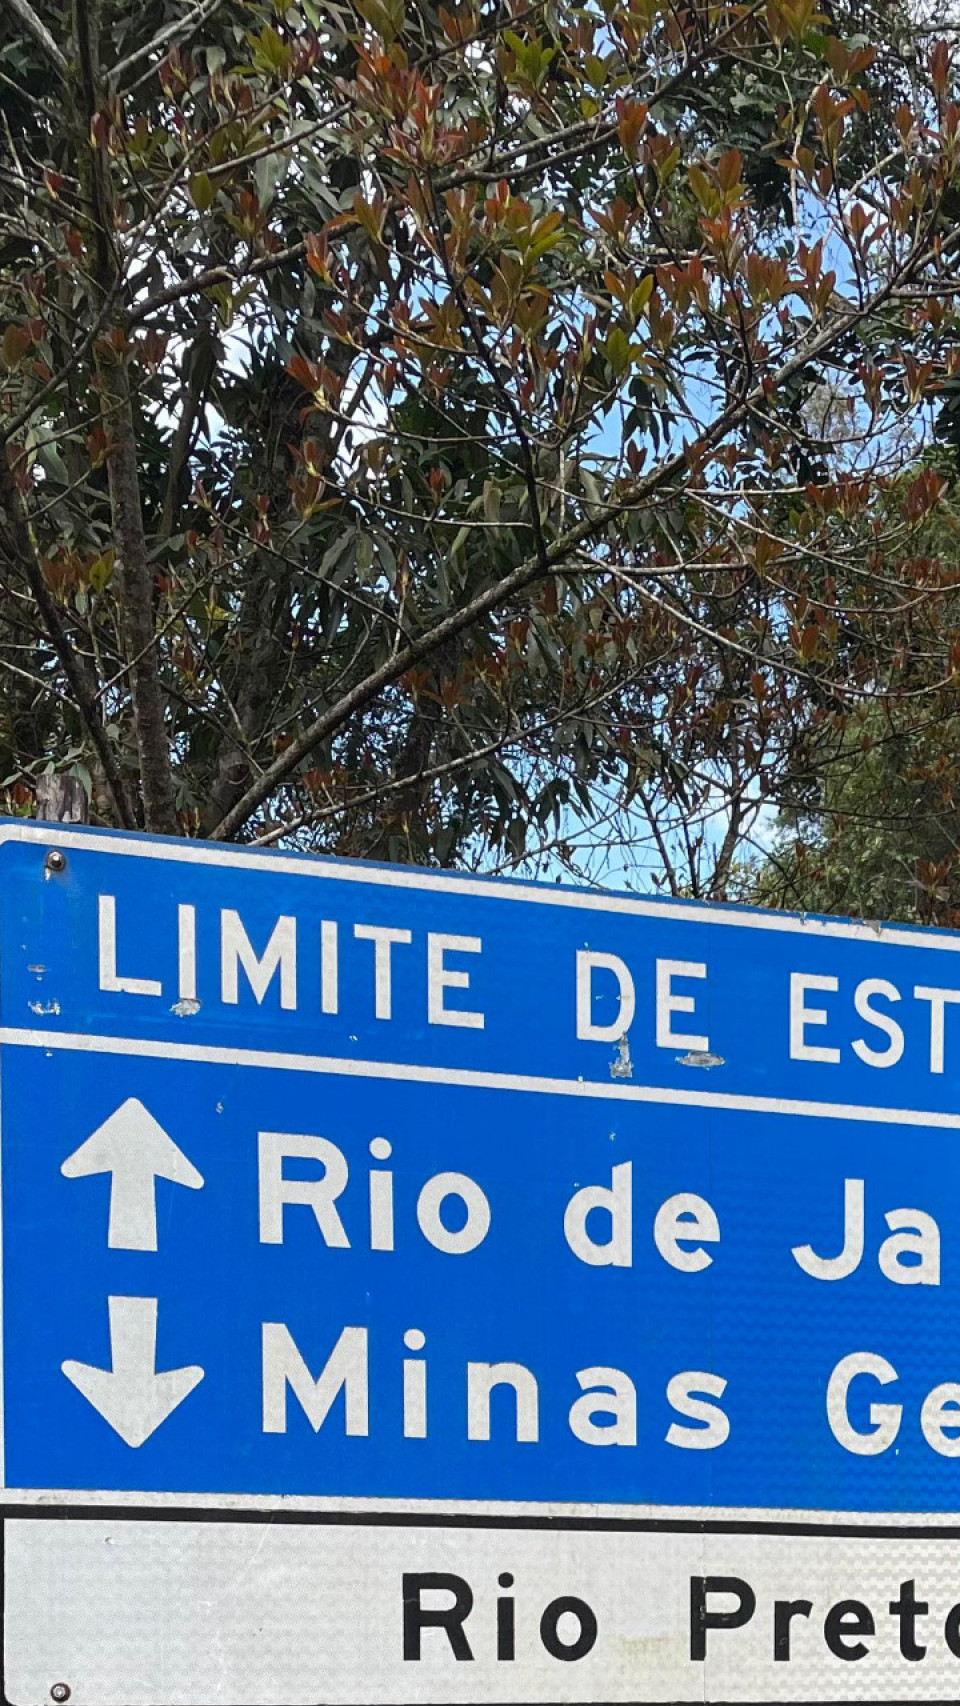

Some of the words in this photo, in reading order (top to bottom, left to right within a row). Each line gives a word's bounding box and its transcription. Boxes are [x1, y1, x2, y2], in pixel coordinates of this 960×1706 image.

[98, 895, 485, 1029] LIMITE
[576, 950, 709, 1052] DE
[258, 1131, 491, 1254] Rio
[563, 1161, 721, 1273] de
[262, 1322, 732, 1450] Minas
[402, 1572, 598, 1662] Rio
